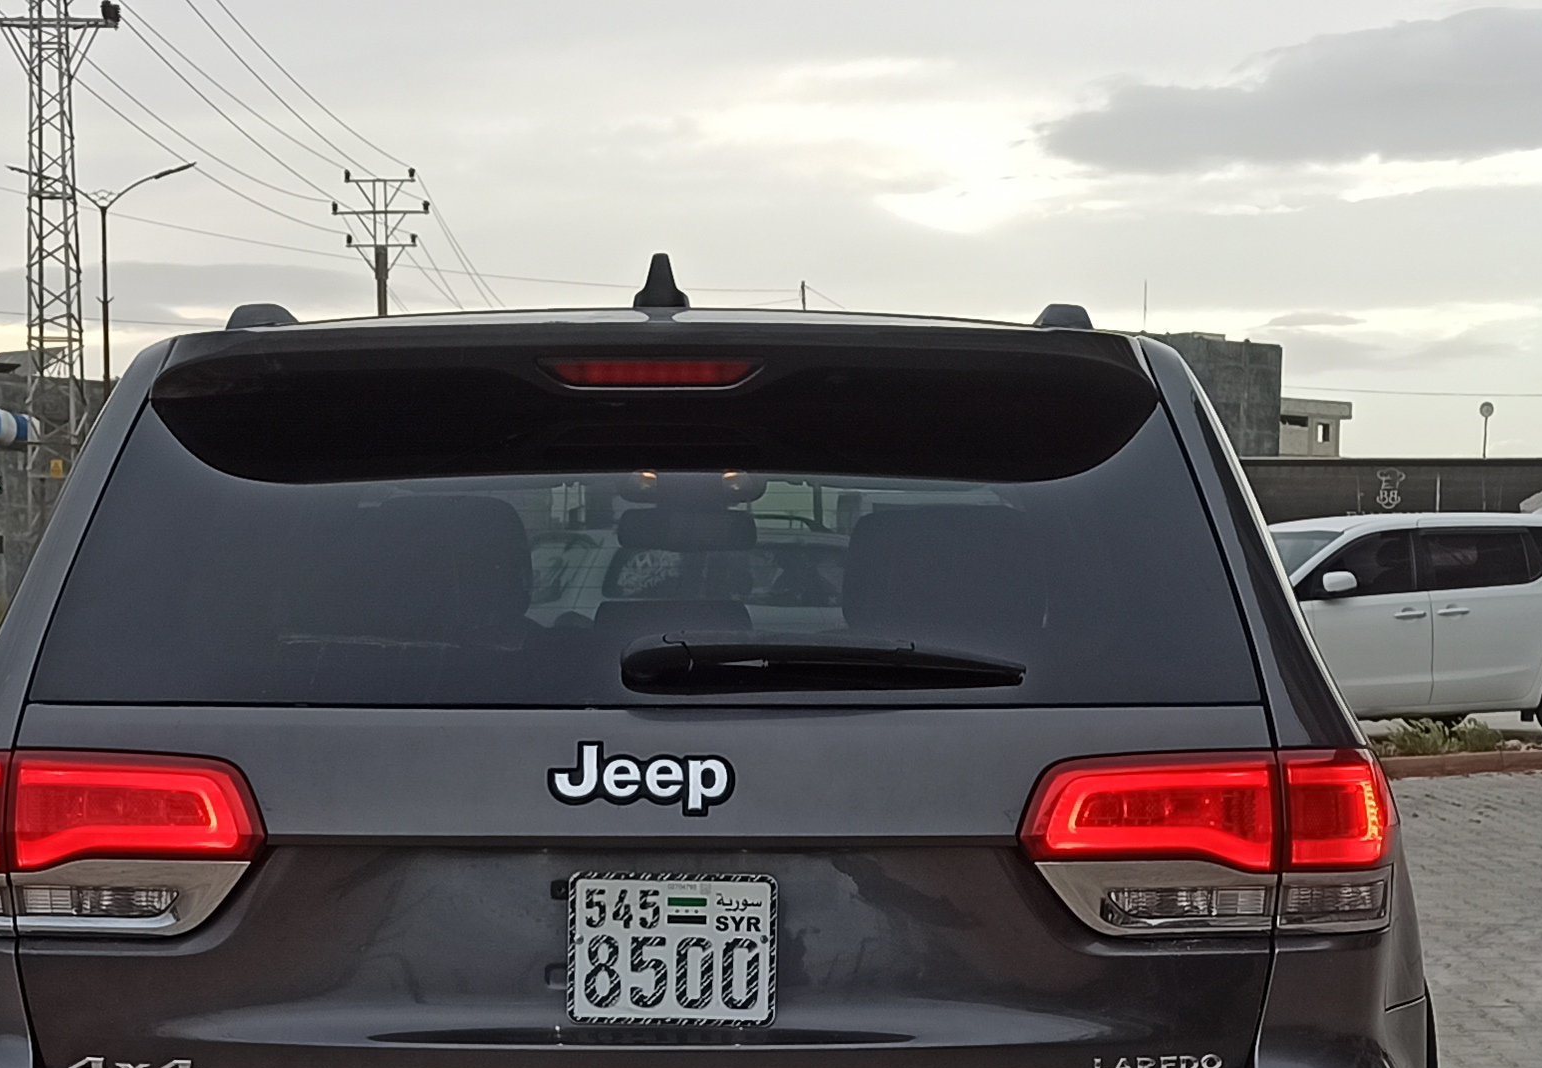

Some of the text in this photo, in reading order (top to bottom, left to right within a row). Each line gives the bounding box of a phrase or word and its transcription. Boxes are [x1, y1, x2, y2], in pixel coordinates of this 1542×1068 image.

[551, 742, 731, 813] Jeep
[585, 888, 660, 929] 545
[715, 893, 763, 912] سورية
[715, 915, 761, 932] SYR
[583, 934, 761, 1010] 8500
